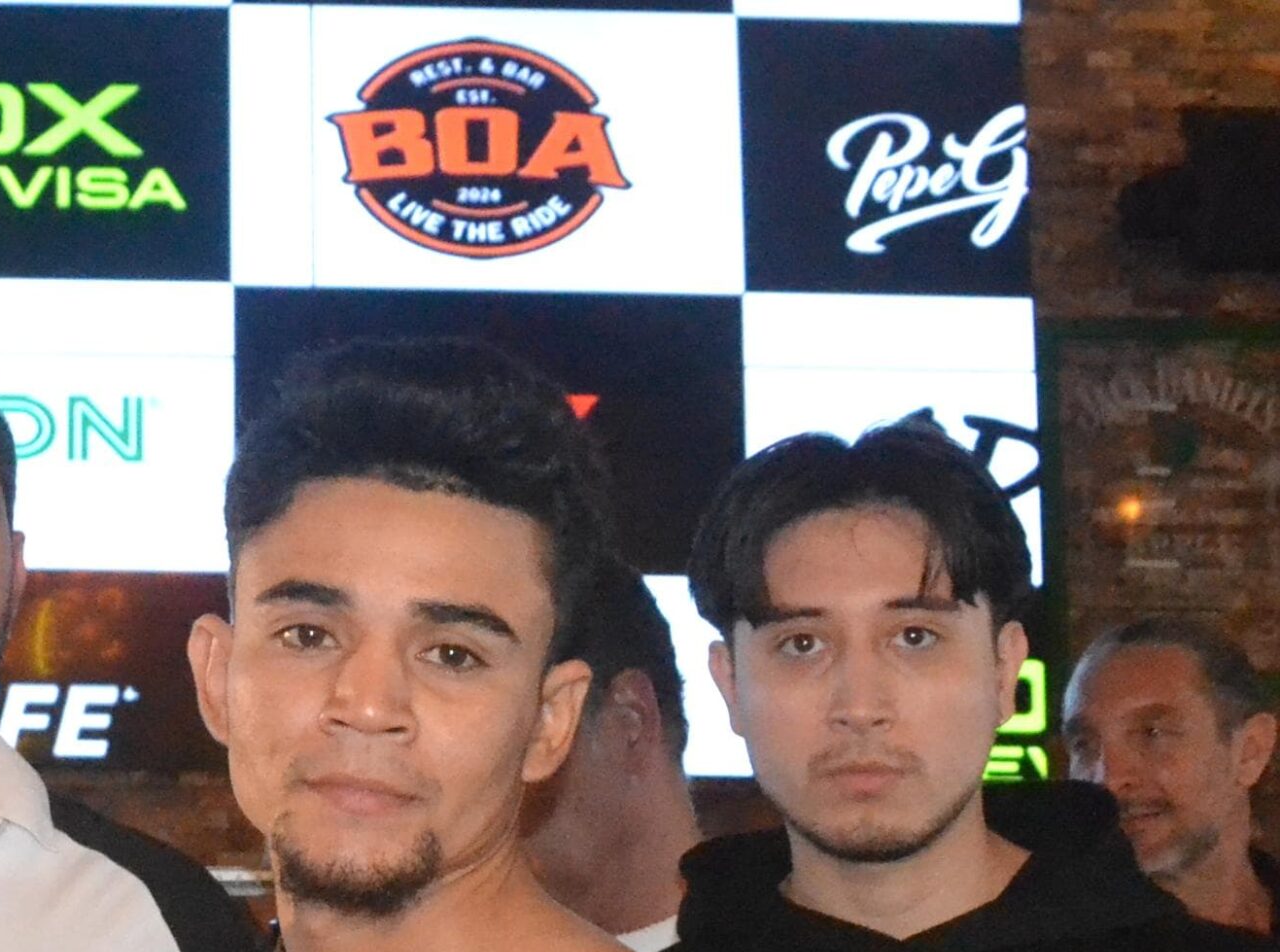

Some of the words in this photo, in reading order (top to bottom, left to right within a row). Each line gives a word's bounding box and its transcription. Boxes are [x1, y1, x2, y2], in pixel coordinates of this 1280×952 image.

[325, 104, 633, 190] BOA
[386, 191, 446, 236] LIVE
[452, 218, 505, 243] THE
[509, 194, 573, 238] RIDE
